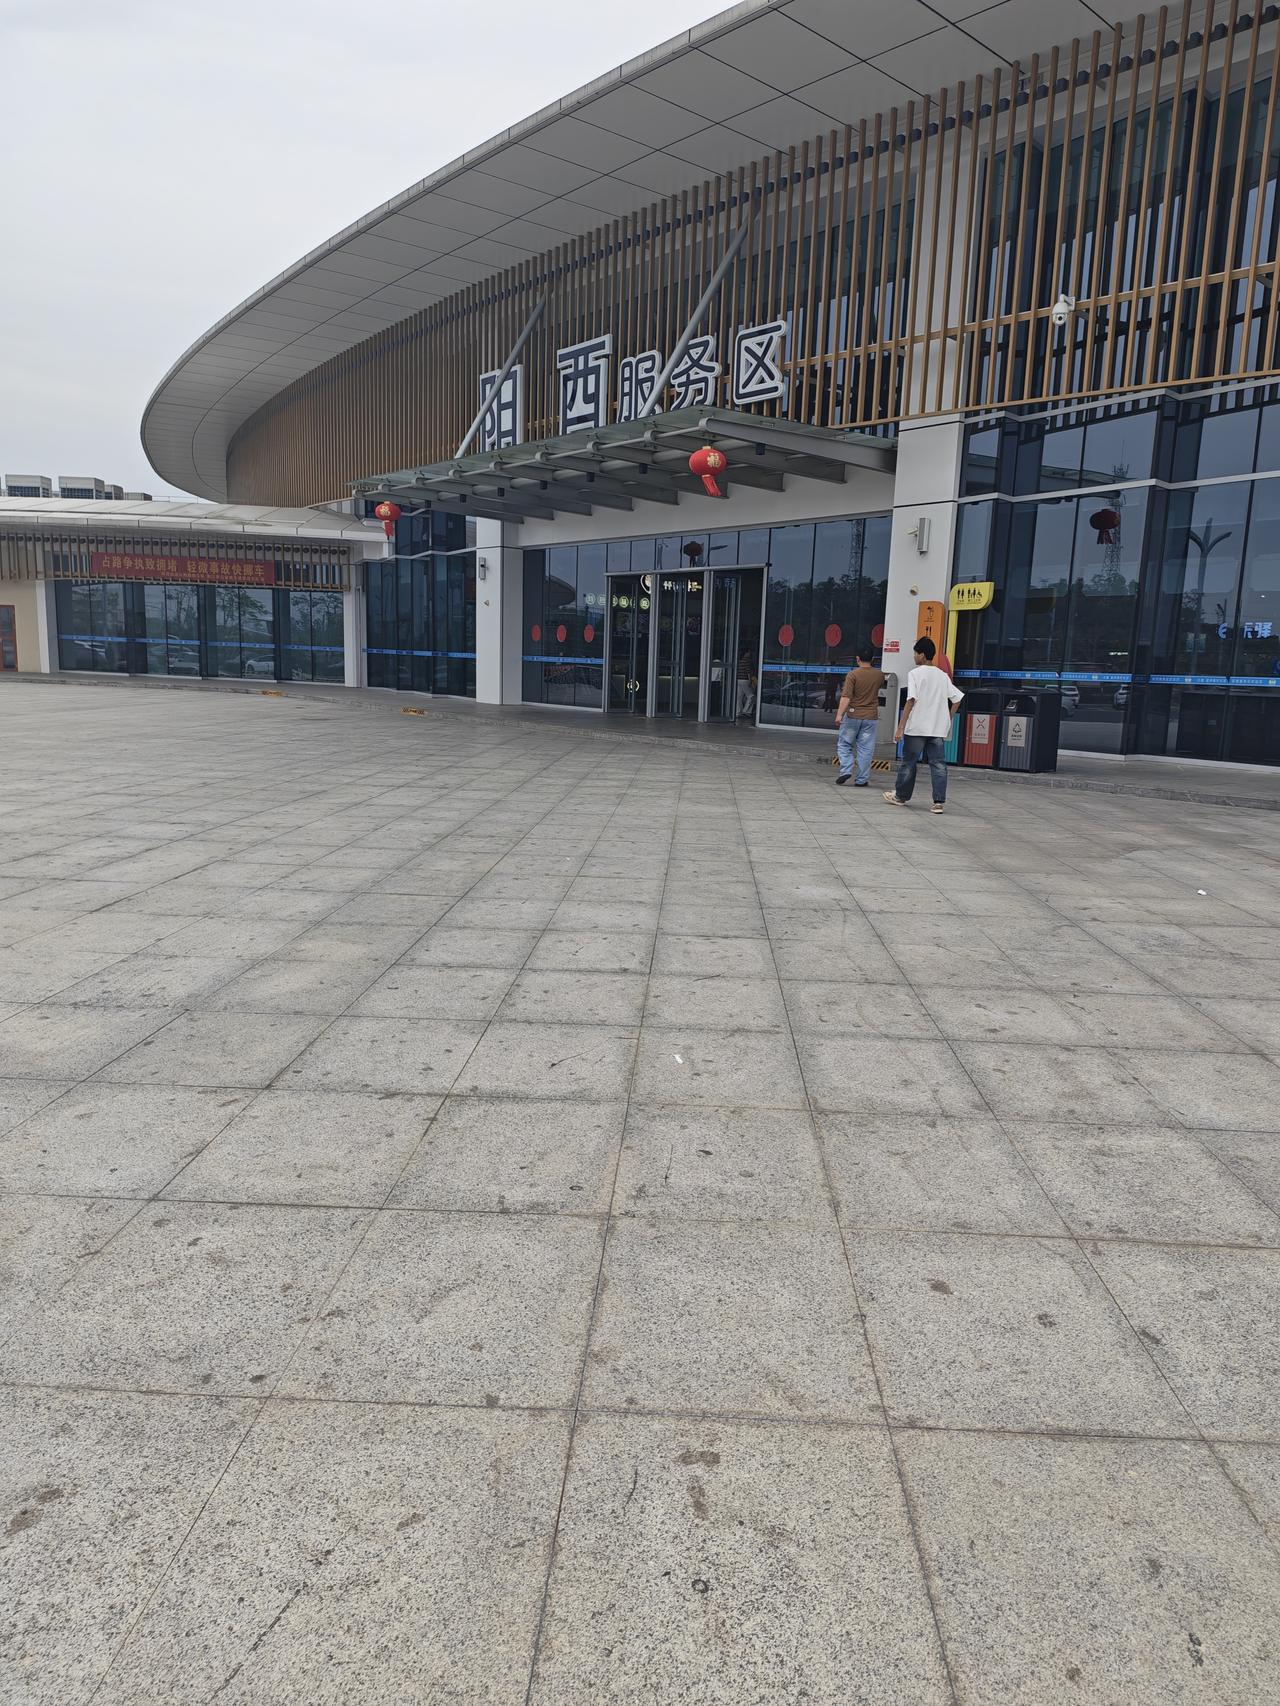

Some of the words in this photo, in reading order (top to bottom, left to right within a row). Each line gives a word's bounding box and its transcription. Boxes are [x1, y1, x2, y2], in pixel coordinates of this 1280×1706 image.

[479, 320, 787, 453] 阳西服务区
